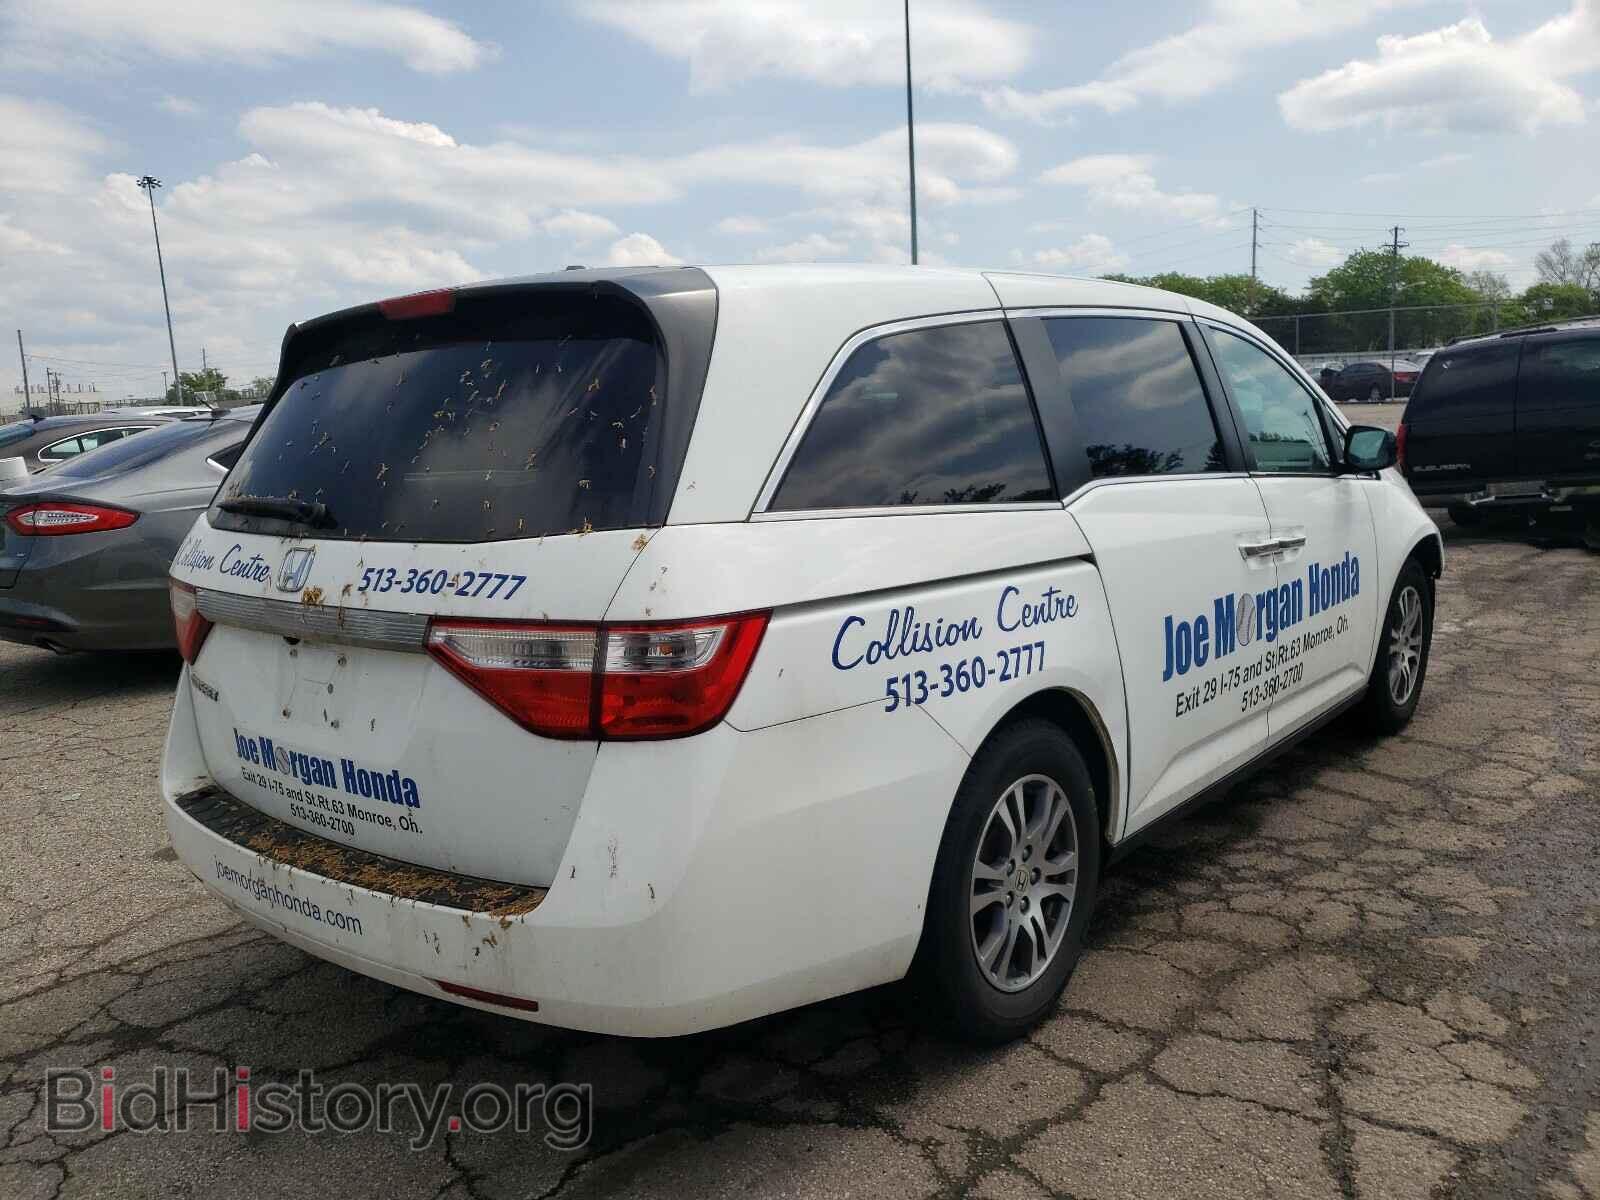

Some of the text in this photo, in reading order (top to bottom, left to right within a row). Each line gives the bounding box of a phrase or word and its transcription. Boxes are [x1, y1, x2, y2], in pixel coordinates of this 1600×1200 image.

[220, 544, 269, 582] Centre
[357, 567, 527, 600] 513-360-2777
[831, 586, 1079, 670] Collision Centre
[1163, 615, 1209, 682] Joe
[1308, 551, 1360, 617] Honda
[885, 641, 1045, 712] 513-360-2777
[1175, 690, 1201, 718] Exit
[1203, 677, 1218, 703] 29
[1220, 666, 1241, 695] I-75
[1243, 656, 1263, 682] and
[1303, 624, 1336, 654] Monroe,
[1241, 662, 1304, 712] 513-360-2700
[233, 727, 259, 764] Joe
[340, 758, 421, 808] Honda
[241, 767, 257, 782] Exit
[257, 774, 267, 788] 29
[268, 776, 285, 797] I-75
[286, 786, 303, 802] and
[347, 803, 397, 831] Monroe,
[399, 815, 423, 834] Oh.
[290, 804, 355, 836] 513-360-2700
[214, 854, 363, 936] joemorganhonda.com
